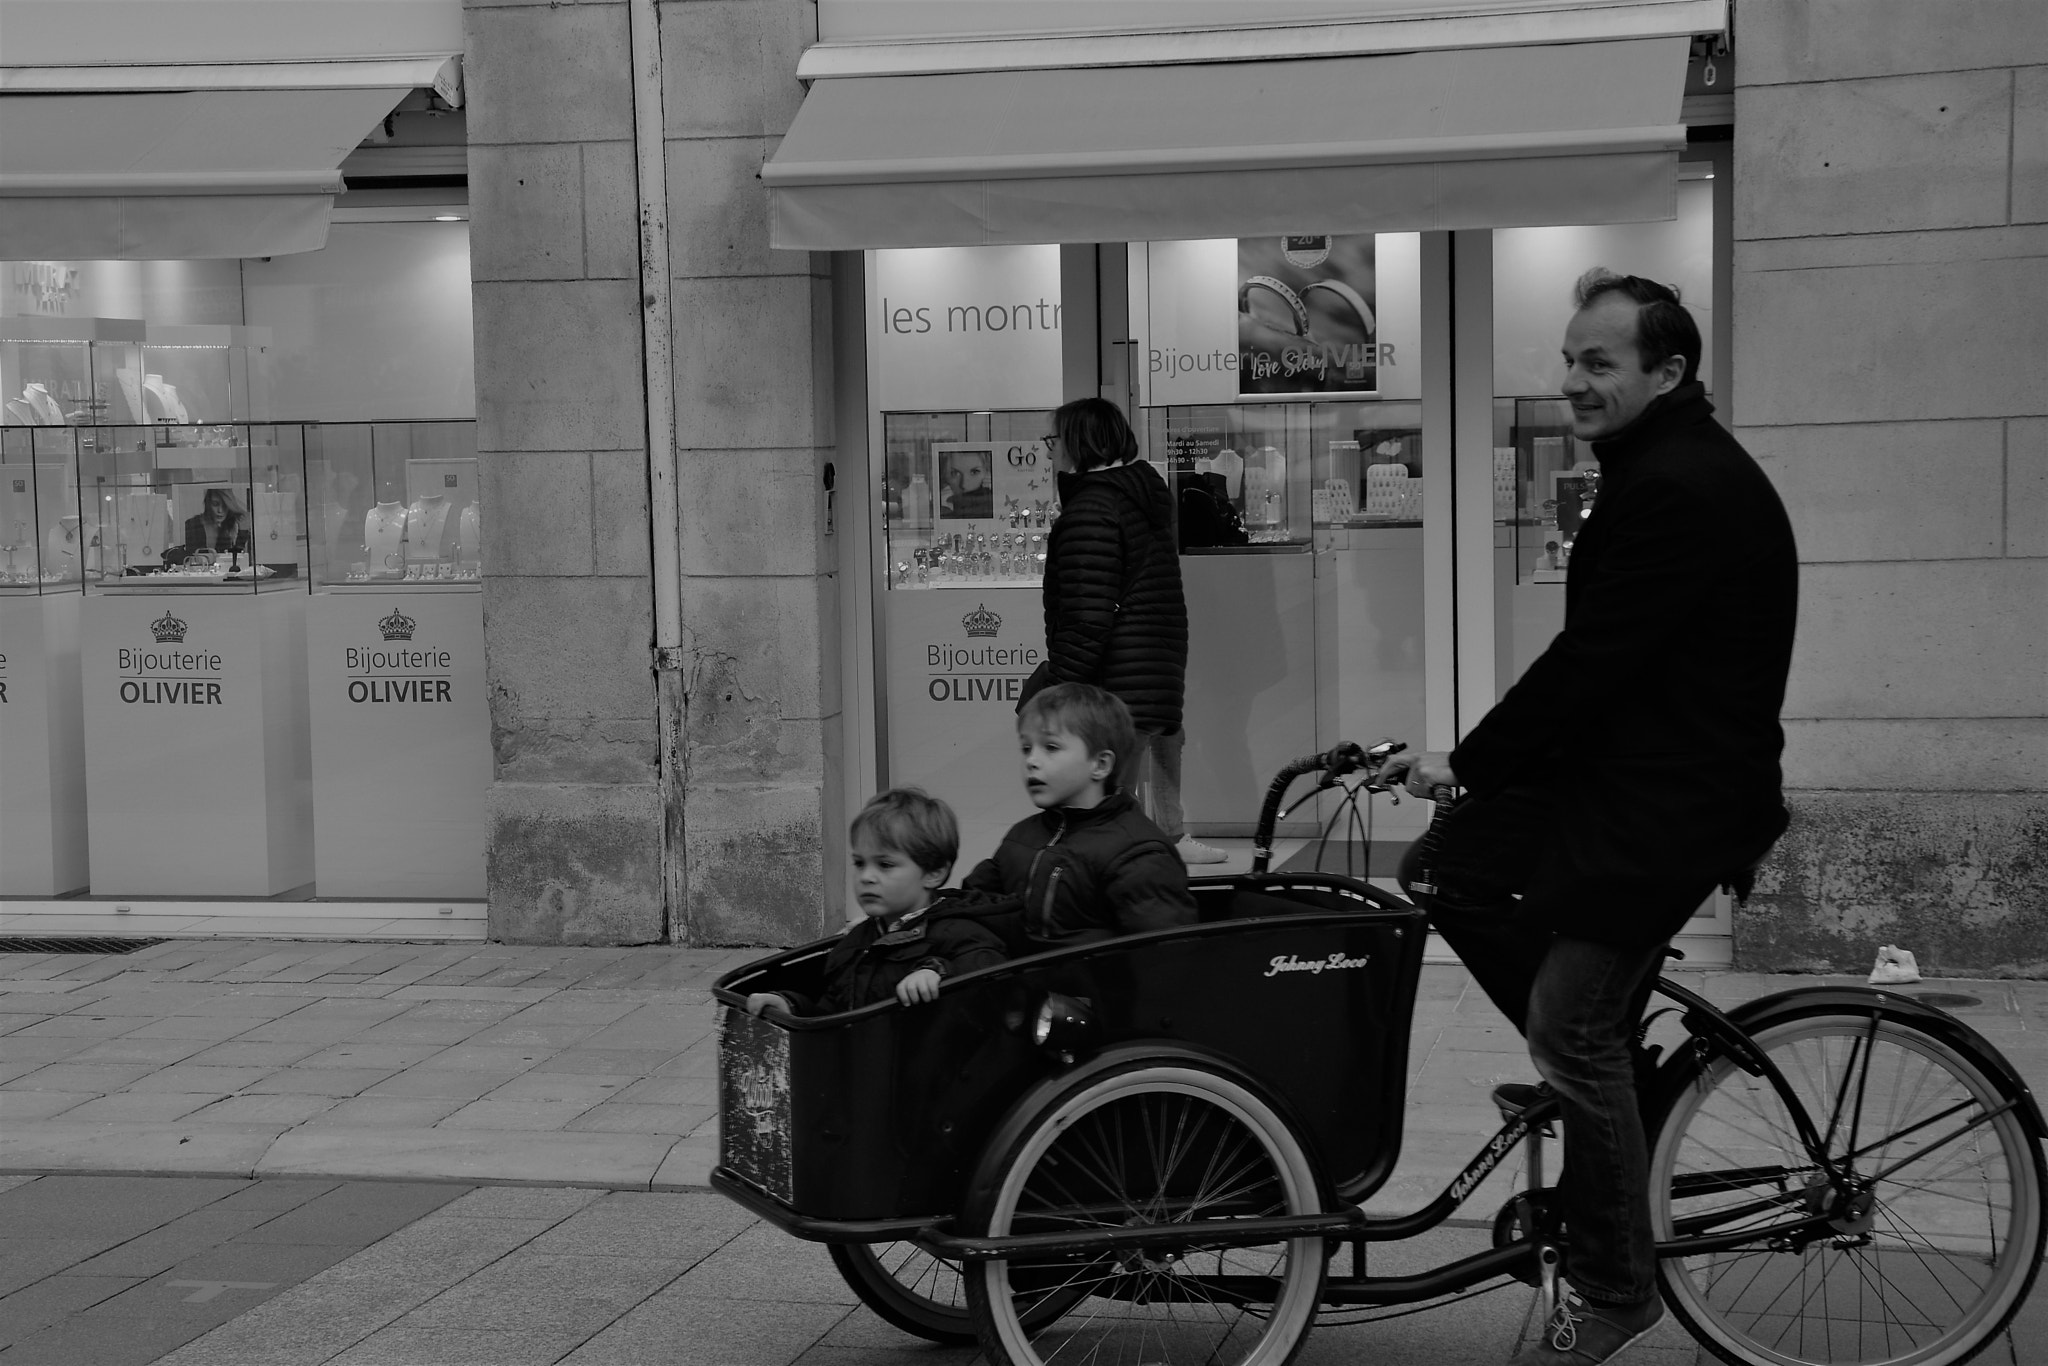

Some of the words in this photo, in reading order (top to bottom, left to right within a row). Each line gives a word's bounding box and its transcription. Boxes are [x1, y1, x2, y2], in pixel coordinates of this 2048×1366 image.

[883, 297, 932, 334] les
[1149, 345, 1271, 379] Bijouterie
[1280, 342, 1397, 370] OLIVIER
[1252, 357, 1281, 381] Love
[1195, 439, 1220, 447] Samedi
[1007, 445, 1037, 467] Go
[1563, 481, 1584, 491] PULS
[119, 648, 222, 675] Bijouterie
[346, 646, 451, 674] Bijouterie
[927, 643, 1039, 672] Bijouterie
[120, 681, 223, 705] OLIVIER
[348, 680, 452, 703] OLIVIER
[928, 678, 1028, 702] OLIVIE
[1263, 954, 1328, 978] Johnny
[1324, 952, 1368, 970] Loco
[1450, 1151, 1495, 1203] Johnny
[1490, 1121, 1528, 1158] Loco
